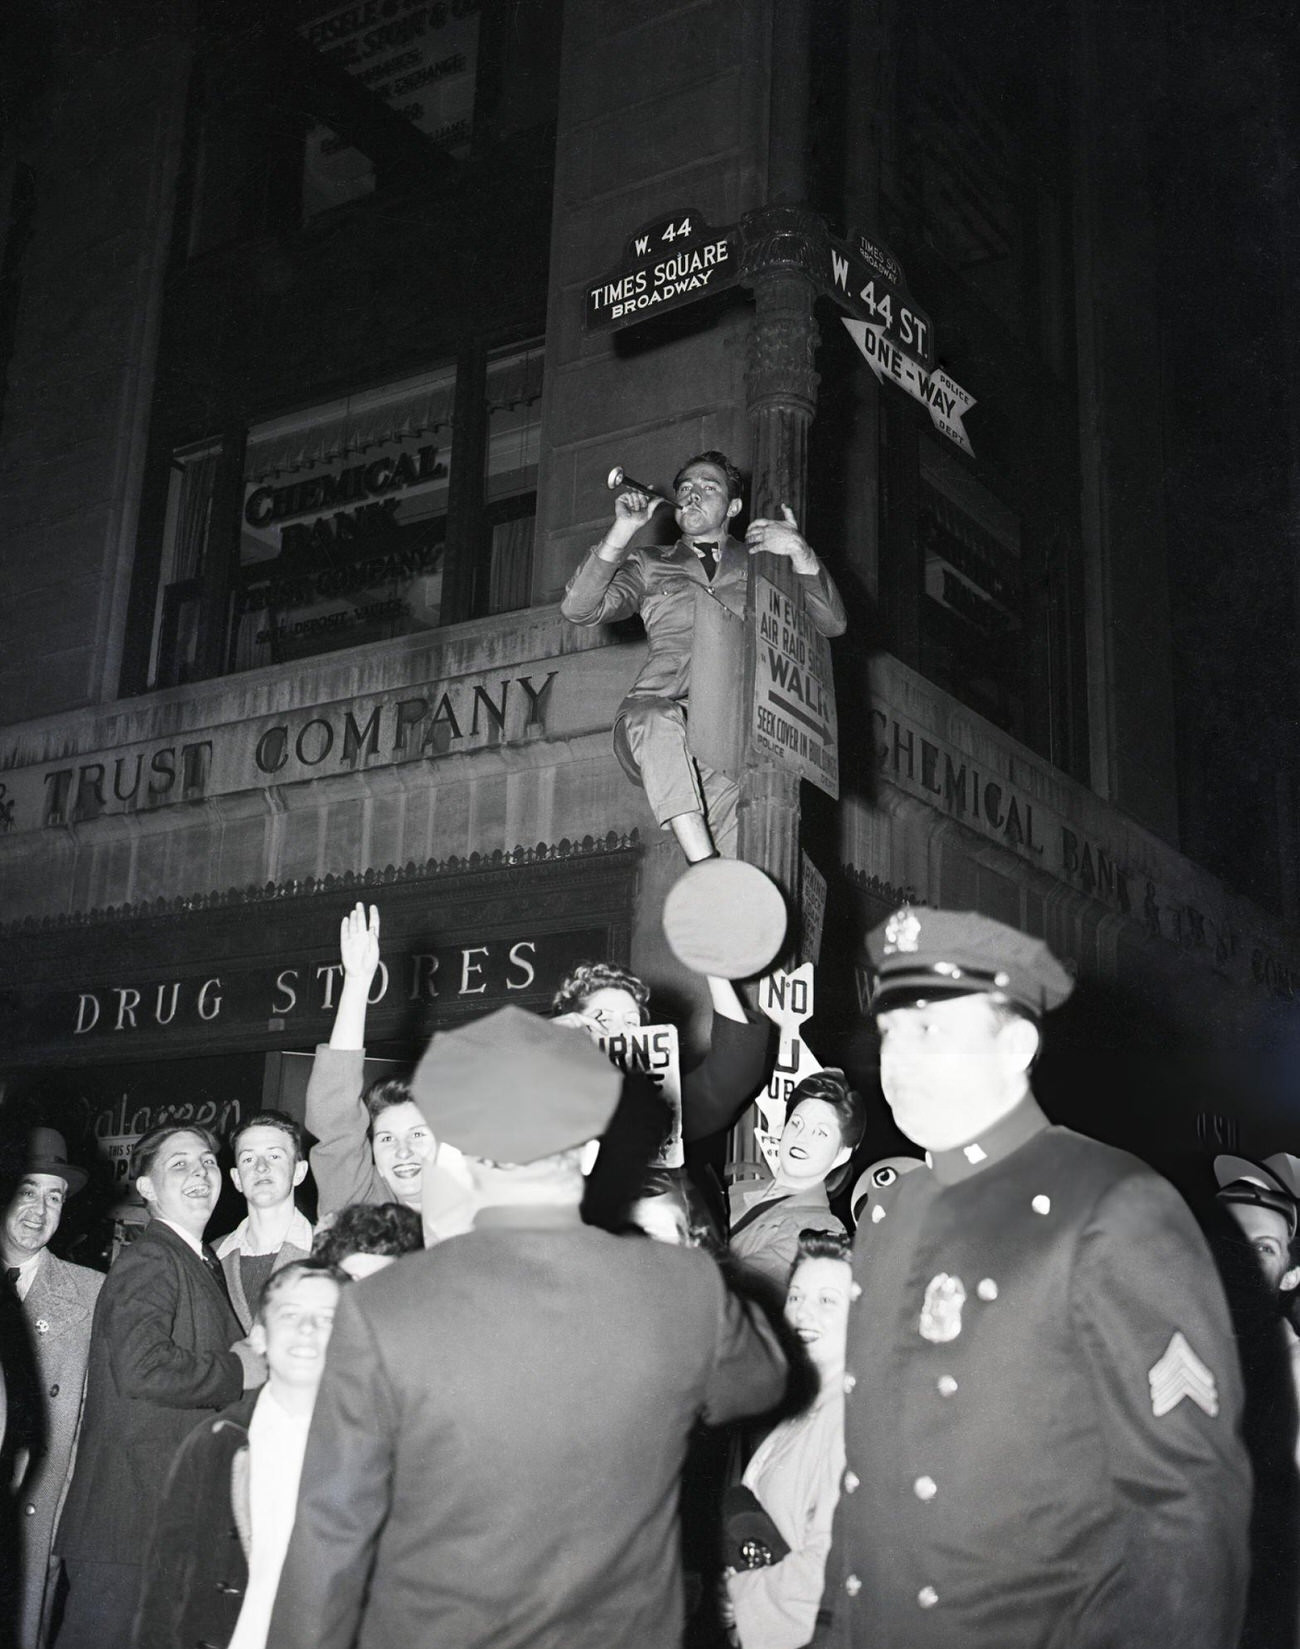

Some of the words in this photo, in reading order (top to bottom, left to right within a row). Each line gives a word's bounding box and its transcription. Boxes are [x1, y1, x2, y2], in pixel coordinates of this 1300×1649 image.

[635, 235, 652, 257] W.
[661, 217, 692, 242] 44
[861, 236, 884, 263] TIMES
[591, 271, 647, 309] TIMES
[654, 240, 729, 286] SQUARE
[611, 269, 714, 319] BROADWAY
[831, 248, 852, 297] W.
[859, 280, 893, 329] 44
[899, 307, 928, 359] ST.
[865, 327, 956, 419] ONE-WAY
[940, 375, 970, 405] POLICE
[245, 445, 446, 528] CHEMICAL
[294, 610, 348, 633] DEPOSIT
[769, 588, 780, 618] IN
[760, 612, 779, 645] AIR
[783, 627, 806, 666] RAID
[768, 646, 830, 725] WALK
[44, 741, 213, 823] TRUST
[255, 671, 560, 774] COMPANY
[757, 705, 777, 738] SEEK
[777, 718, 799, 753] COVER
[799, 732, 808, 759] IN
[757, 734, 785, 758] POLICE
[871, 708, 1044, 853] CHEMICAL
[73, 977, 226, 1034] DRUG
[272, 941, 538, 1014] STORES
[768, 973, 808, 1015] NO
[599, 1033, 671, 1072] RNS
[109, 1144, 124, 1157] THIS
